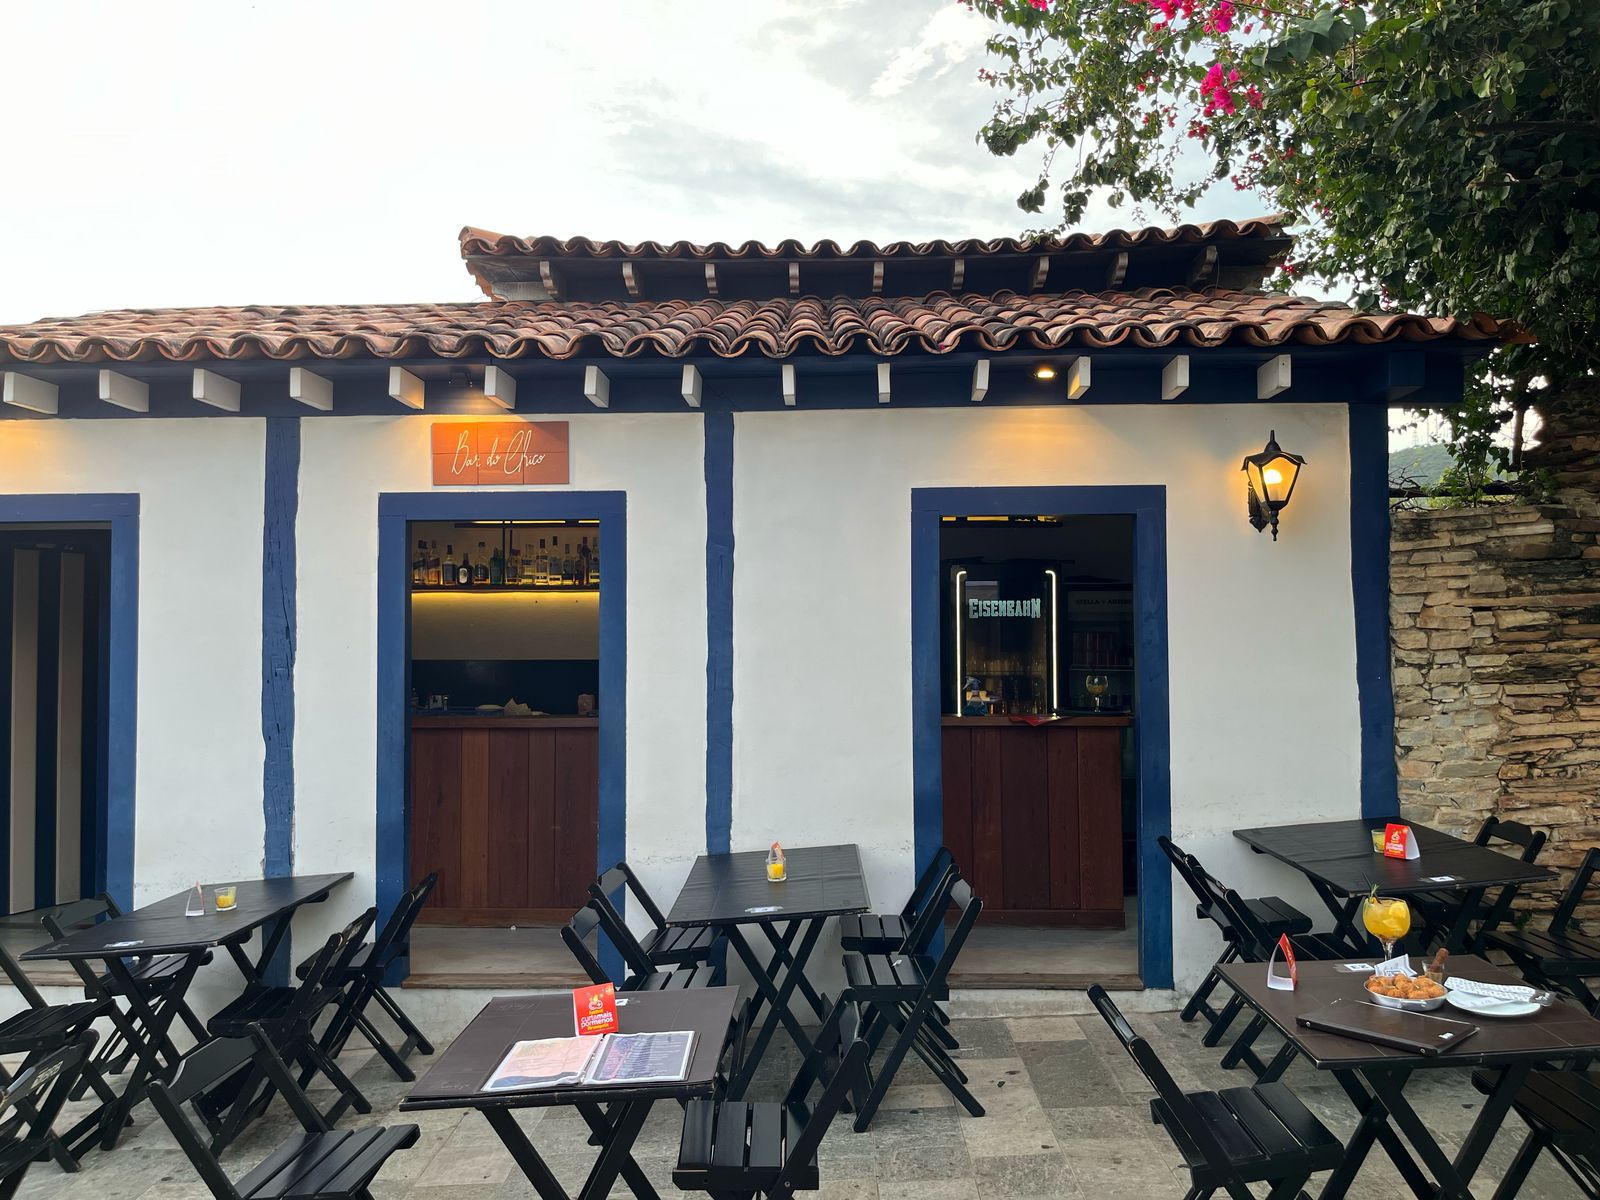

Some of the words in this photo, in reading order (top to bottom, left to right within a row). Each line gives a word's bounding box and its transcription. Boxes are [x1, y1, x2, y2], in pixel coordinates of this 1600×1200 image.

[452, 430, 481, 475] Bar
[487, 437, 502, 467] do
[504, 430, 546, 475] Chico
[969, 598, 1041, 618] EISENBAHN
